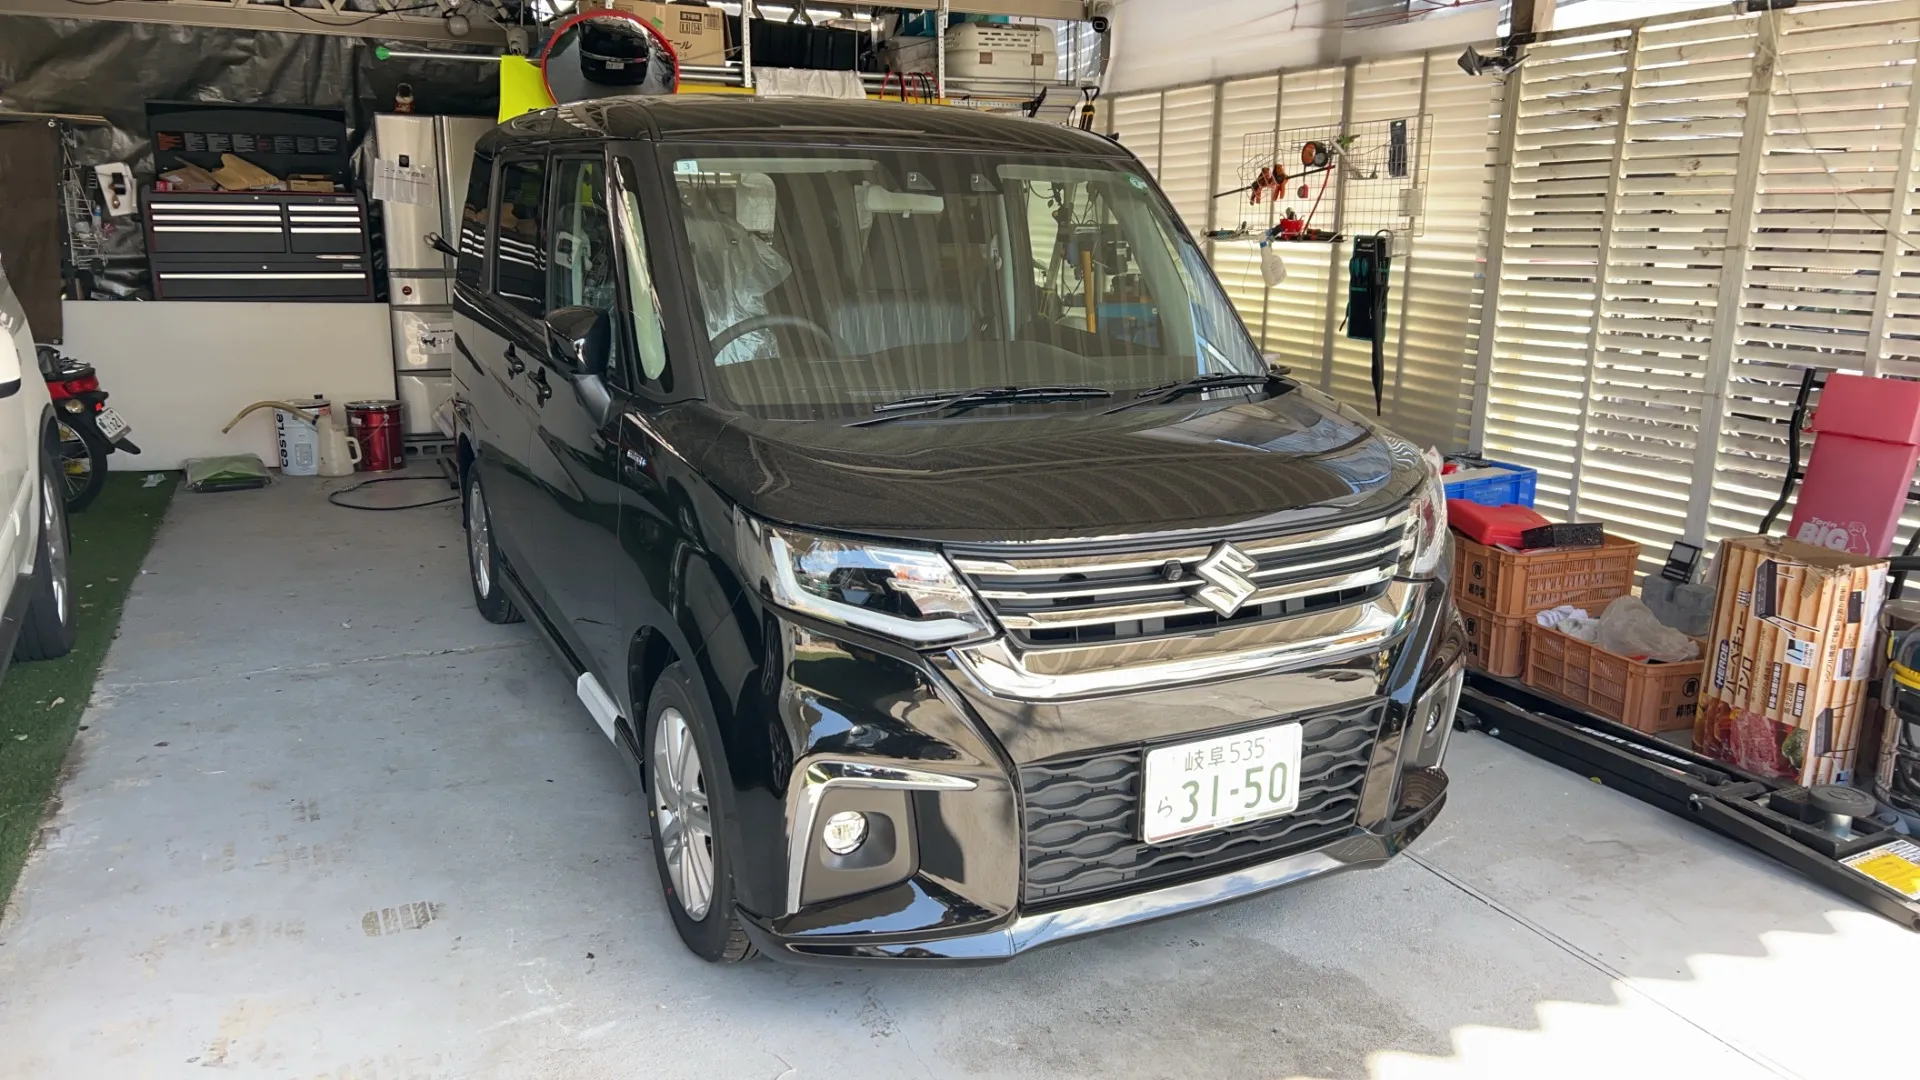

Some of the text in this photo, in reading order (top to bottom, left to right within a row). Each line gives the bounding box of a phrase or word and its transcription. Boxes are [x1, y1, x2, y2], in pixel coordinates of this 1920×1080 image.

[1795, 522, 1850, 551] BIG
[1811, 516, 1838, 529] Torin
[1725, 611, 1746, 696] バーベキュー
[1738, 655, 1753, 700] コンロ
[1157, 796, 1174, 818] ら
[1179, 761, 1289, 823] 31-50
